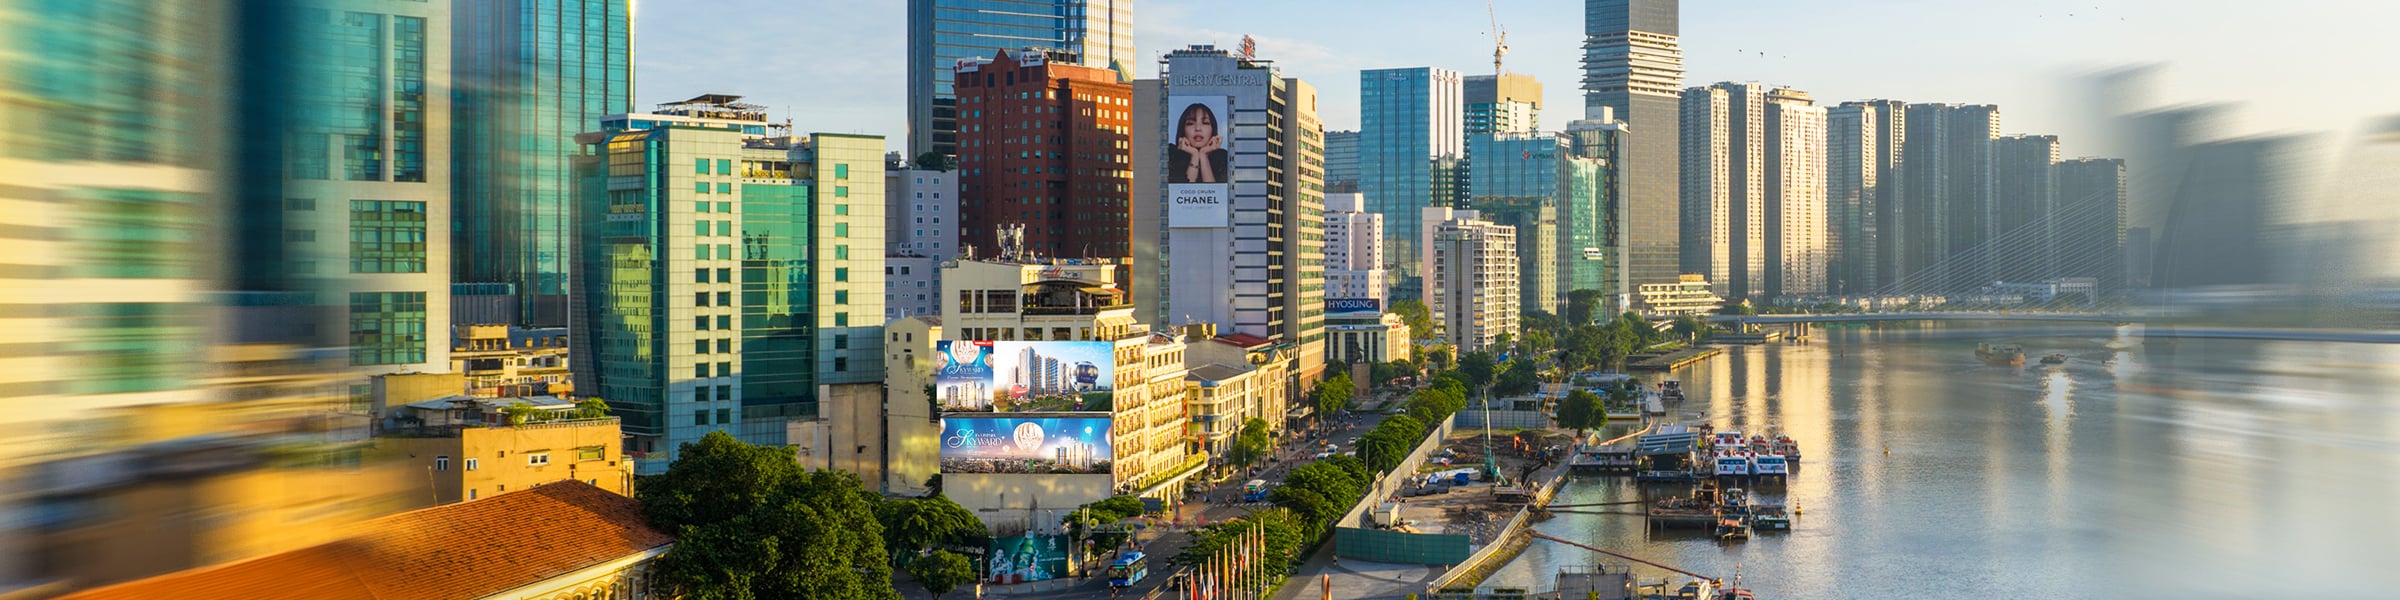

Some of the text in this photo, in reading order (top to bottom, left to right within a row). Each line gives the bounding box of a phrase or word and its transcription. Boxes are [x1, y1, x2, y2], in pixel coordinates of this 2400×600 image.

[1174, 74, 1264, 86] LIBERTY CENTRAL
[1176, 196, 1219, 204] CHANEL
[1328, 300, 1373, 309] HYOSUNG
